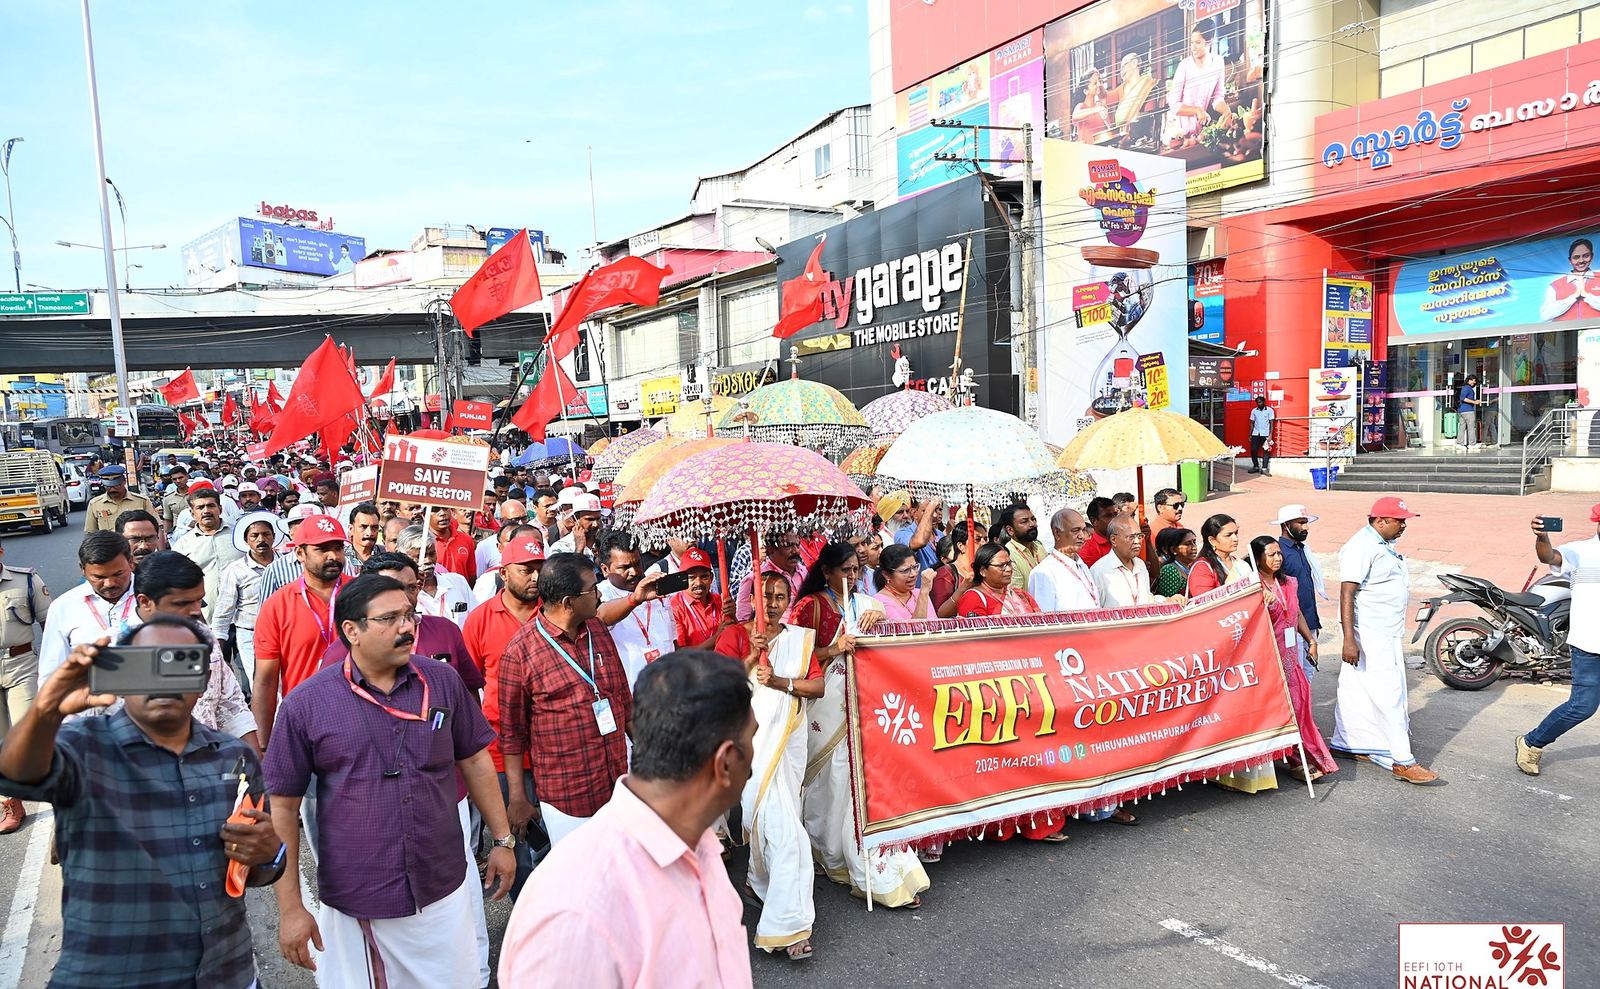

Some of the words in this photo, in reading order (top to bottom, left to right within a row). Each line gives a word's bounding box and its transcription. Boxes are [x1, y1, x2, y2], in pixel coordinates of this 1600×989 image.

[1003, 48, 1032, 66] BAZAAR
[1097, 163, 1117, 173] SMART
[1098, 171, 1119, 179] BAZAAR
[630, 237, 641, 249] FOR
[642, 231, 659, 247] SALE
[854, 330, 875, 347] THE
[876, 321, 917, 344] MOBILE
[916, 311, 960, 338] STORE
[460, 412, 487, 421] PUNJAB
[413, 467, 451, 485] SAVE
[350, 483, 364, 493] SAVE
[388, 482, 427, 497] POWER
[429, 486, 472, 501] SECTOR
[1217, 610, 1250, 628] EEFI
[931, 665, 962, 679] ELECTRICITY
[963, 662, 994, 676] EMPLOYEES
[992, 659, 1022, 673] FEDERATION
[1021, 659, 1030, 669] OF
[1029, 657, 1043, 669] INDIA
[1054, 648, 1085, 677] 10
[1065, 649, 1221, 702] NATIONAL
[1074, 662, 1258, 729] CONFERENCE
[932, 672, 1057, 751] EEFI
[975, 758, 999, 774] 2025
[1001, 755, 1043, 769] MARCH
[1045, 752, 1055, 764] 10
[1075, 745, 1086, 758] 12
[1191, 712, 1222, 731] KERALA
